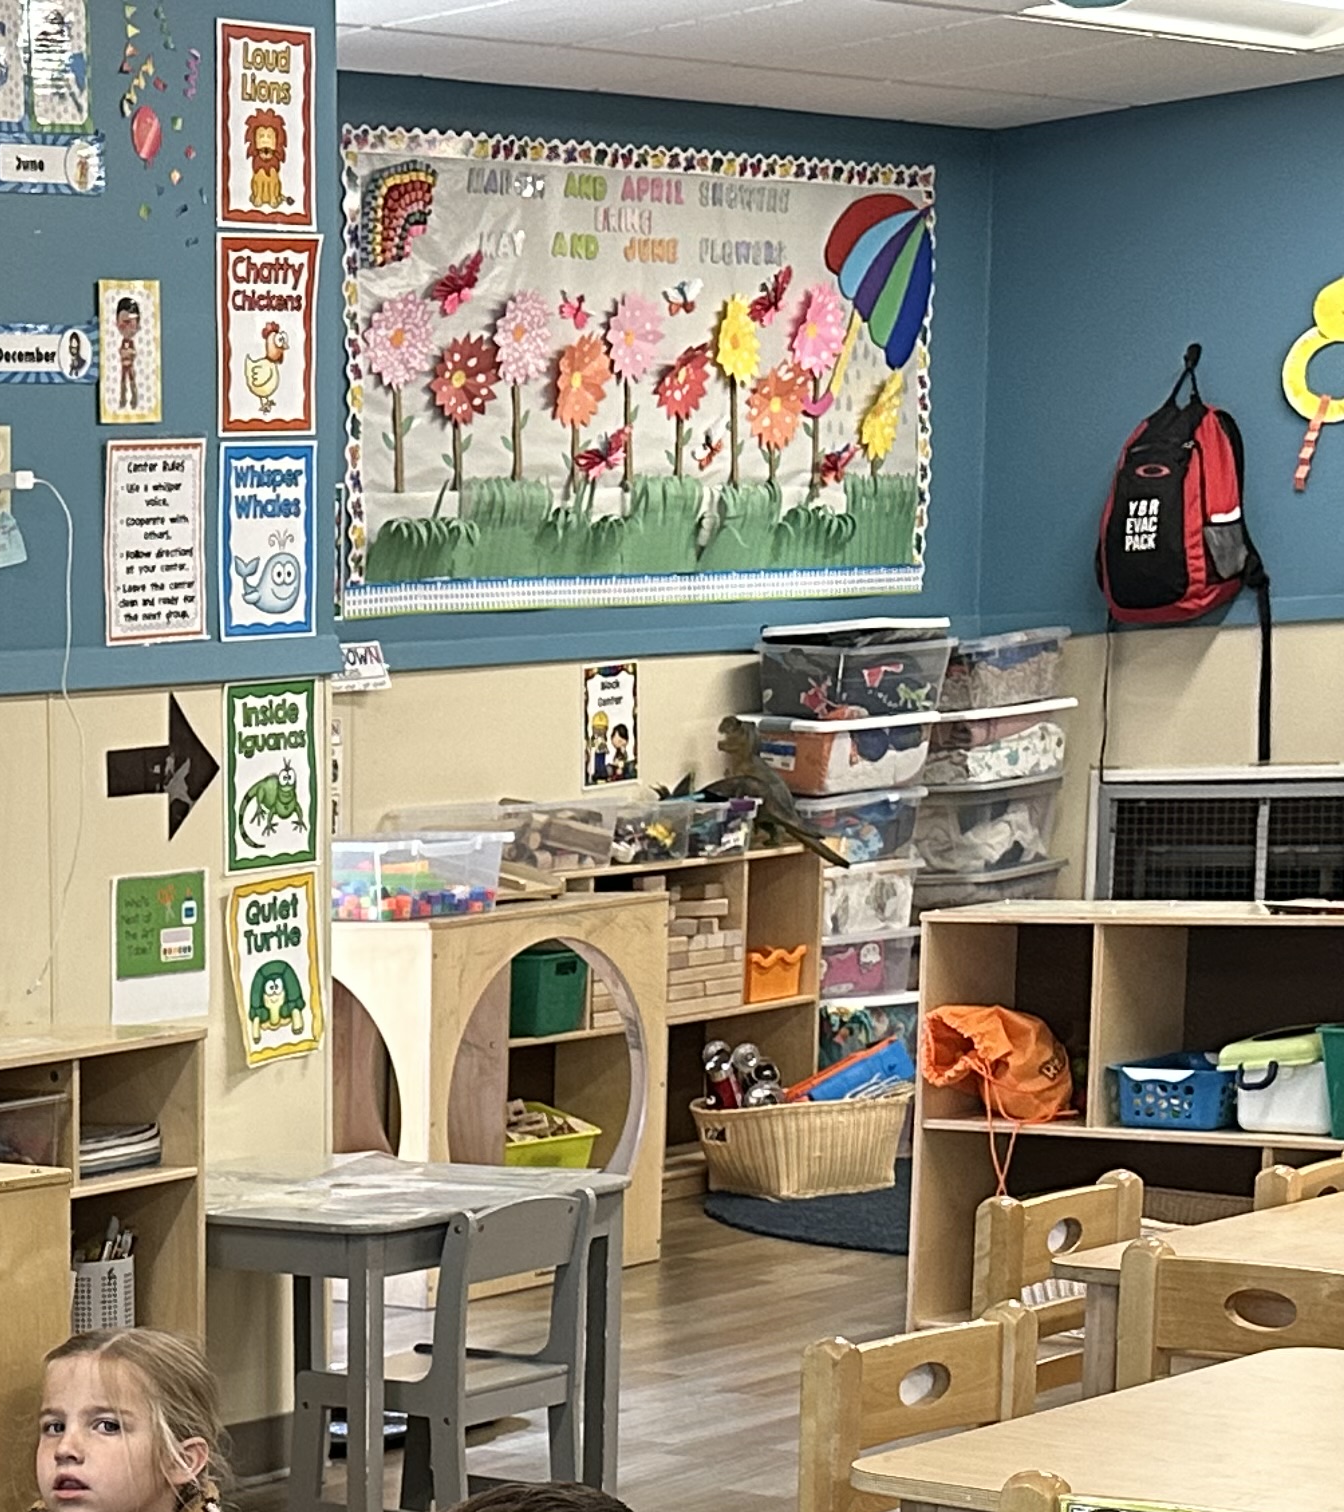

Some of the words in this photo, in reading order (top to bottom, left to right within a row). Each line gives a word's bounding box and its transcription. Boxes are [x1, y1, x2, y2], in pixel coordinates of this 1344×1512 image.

[241, 45, 291, 75] Loud
[241, 74, 291, 105] Lions
[563, 173, 608, 202] AND
[620, 175, 685, 205] APRIL
[551, 233, 599, 260] AND
[624, 236, 679, 263] JUNE
[231, 257, 304, 290] Chatty
[230, 288, 303, 314] Chickens
[234, 465, 303, 492] Whisper
[235, 495, 301, 519] Whales
[1128, 499, 1160, 517] YBR
[1125, 516, 1159, 534] EVAC
[1125, 533, 1156, 552] PACK
[242, 699, 300, 728] Inside
[237, 730, 306, 759] Iguanas
[245, 896, 300, 927] Quiet
[243, 926, 301, 955] Turtle
